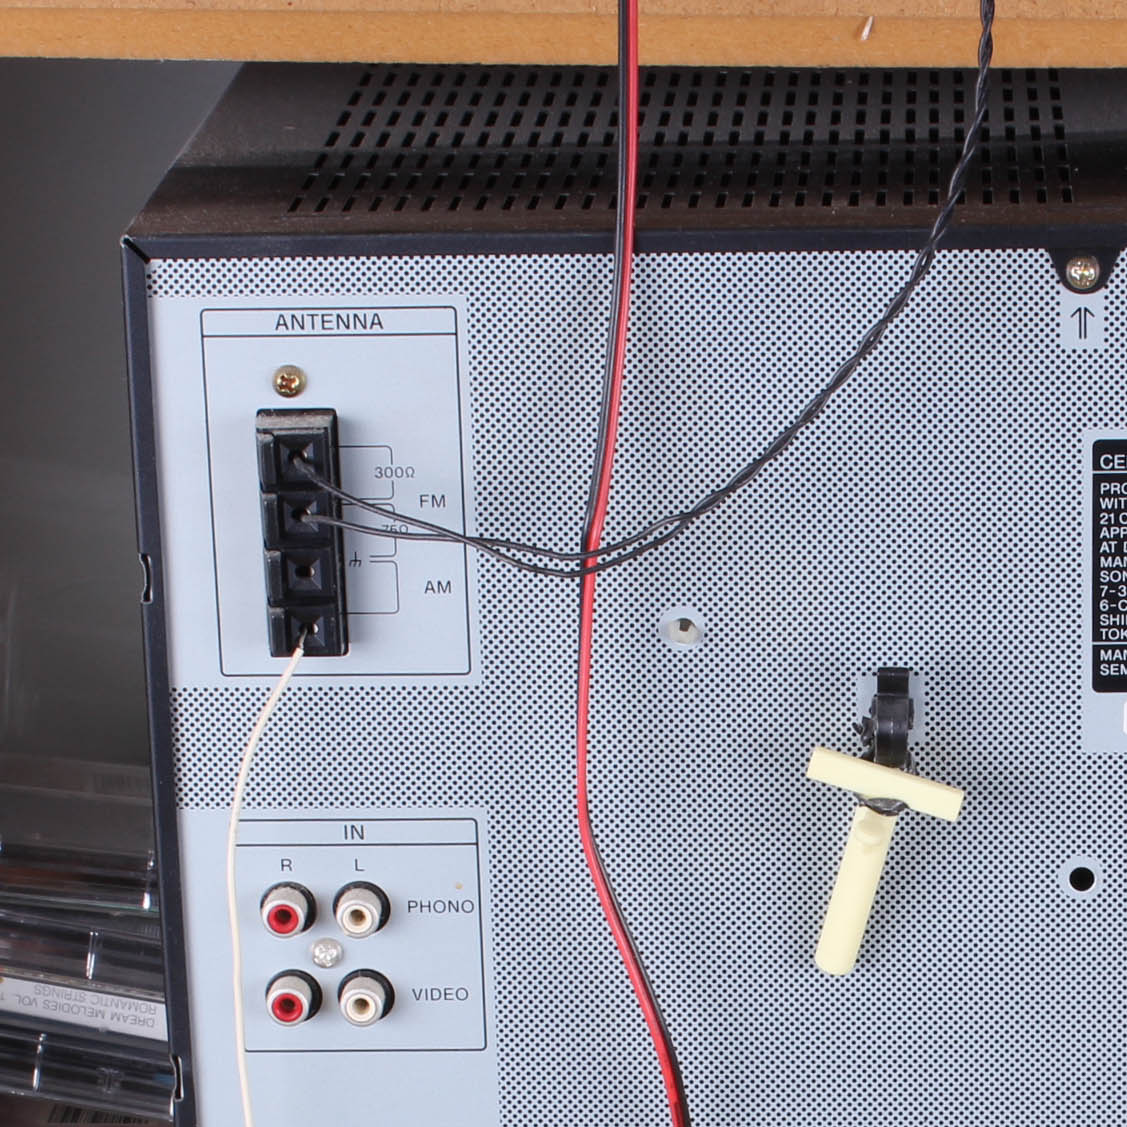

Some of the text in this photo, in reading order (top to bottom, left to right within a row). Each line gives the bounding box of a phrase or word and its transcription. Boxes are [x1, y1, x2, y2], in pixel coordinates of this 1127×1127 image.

[275, 313, 383, 331] ANTENNA
[420, 494, 446, 508] FM
[1100, 542, 1117, 553] AT
[424, 581, 451, 594] AM
[344, 825, 364, 840] IN
[281, 859, 364, 871] R L
[407, 900, 474, 913] PHONO
[412, 987, 468, 1001] VIDEO
[91, 995, 156, 1015] ROMANTIC
[43, 1000, 155, 1027] DREAM MELODIES
